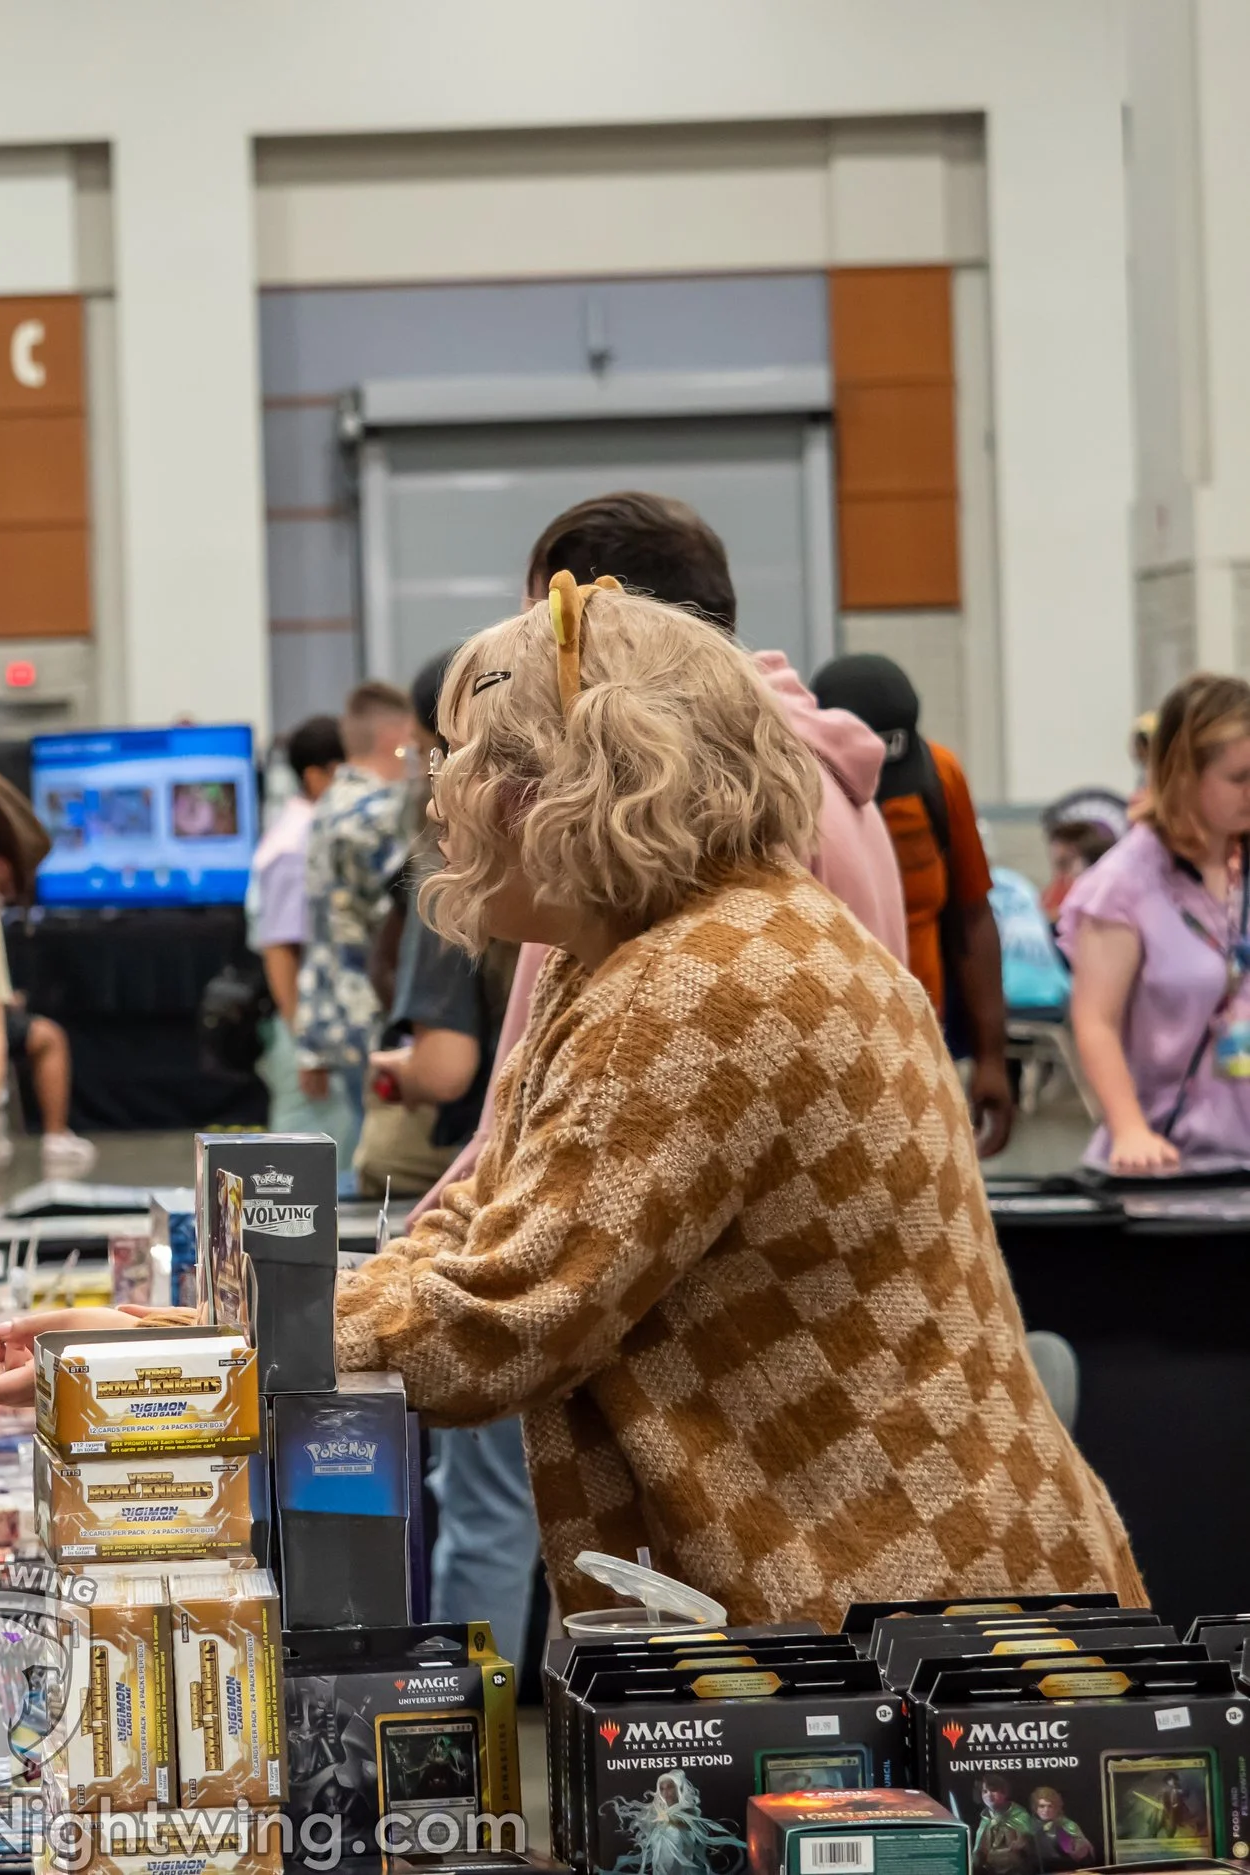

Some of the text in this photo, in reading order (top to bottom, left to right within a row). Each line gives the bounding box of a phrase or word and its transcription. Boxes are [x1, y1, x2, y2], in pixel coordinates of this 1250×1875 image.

[10, 319, 46, 388] C
[243, 1207, 311, 1226] VOLVING
[135, 1368, 182, 1379] VERSUS
[97, 1377, 222, 1398] ROYAL KNIGHTS
[131, 1402, 187, 1412] DIGIMON
[88, 1482, 214, 1502] ROYAL KNIGHTS
[122, 1507, 178, 1517] DIGIMON
[407, 1676, 459, 1690] MAGIC
[493, 1675, 506, 1684] 13+
[139, 1700, 146, 1709] 24
[200, 1640, 224, 1771] ROYAL KNIGHTS
[226, 1676, 237, 1735] DIGIMON
[250, 1694, 256, 1703] 24
[398, 1695, 465, 1705] UNIVERSES BEYOND
[91, 1645, 112, 1777] ROYAL KNIGHTS
[116, 1682, 126, 1742] DIGIMON
[878, 1710, 892, 1718] 13+
[623, 1719, 723, 1742] MAGIC
[967, 1721, 1070, 1744] MAGIC
[653, 1740, 722, 1749] GATHERING
[996, 1742, 1068, 1751] GATHERING
[606, 1754, 733, 1771] UNIVERSES BEYOND
[950, 1757, 1079, 1772] UNIVERSES BEYOND
[142, 1776, 148, 1784] 12
[883, 1759, 891, 1788] UNCIL
[1238, 1756, 1248, 1817] FELLOWSHIP
[1232, 1810, 1240, 1838] FOOD
[147, 1860, 206, 1871] DIGIMON
